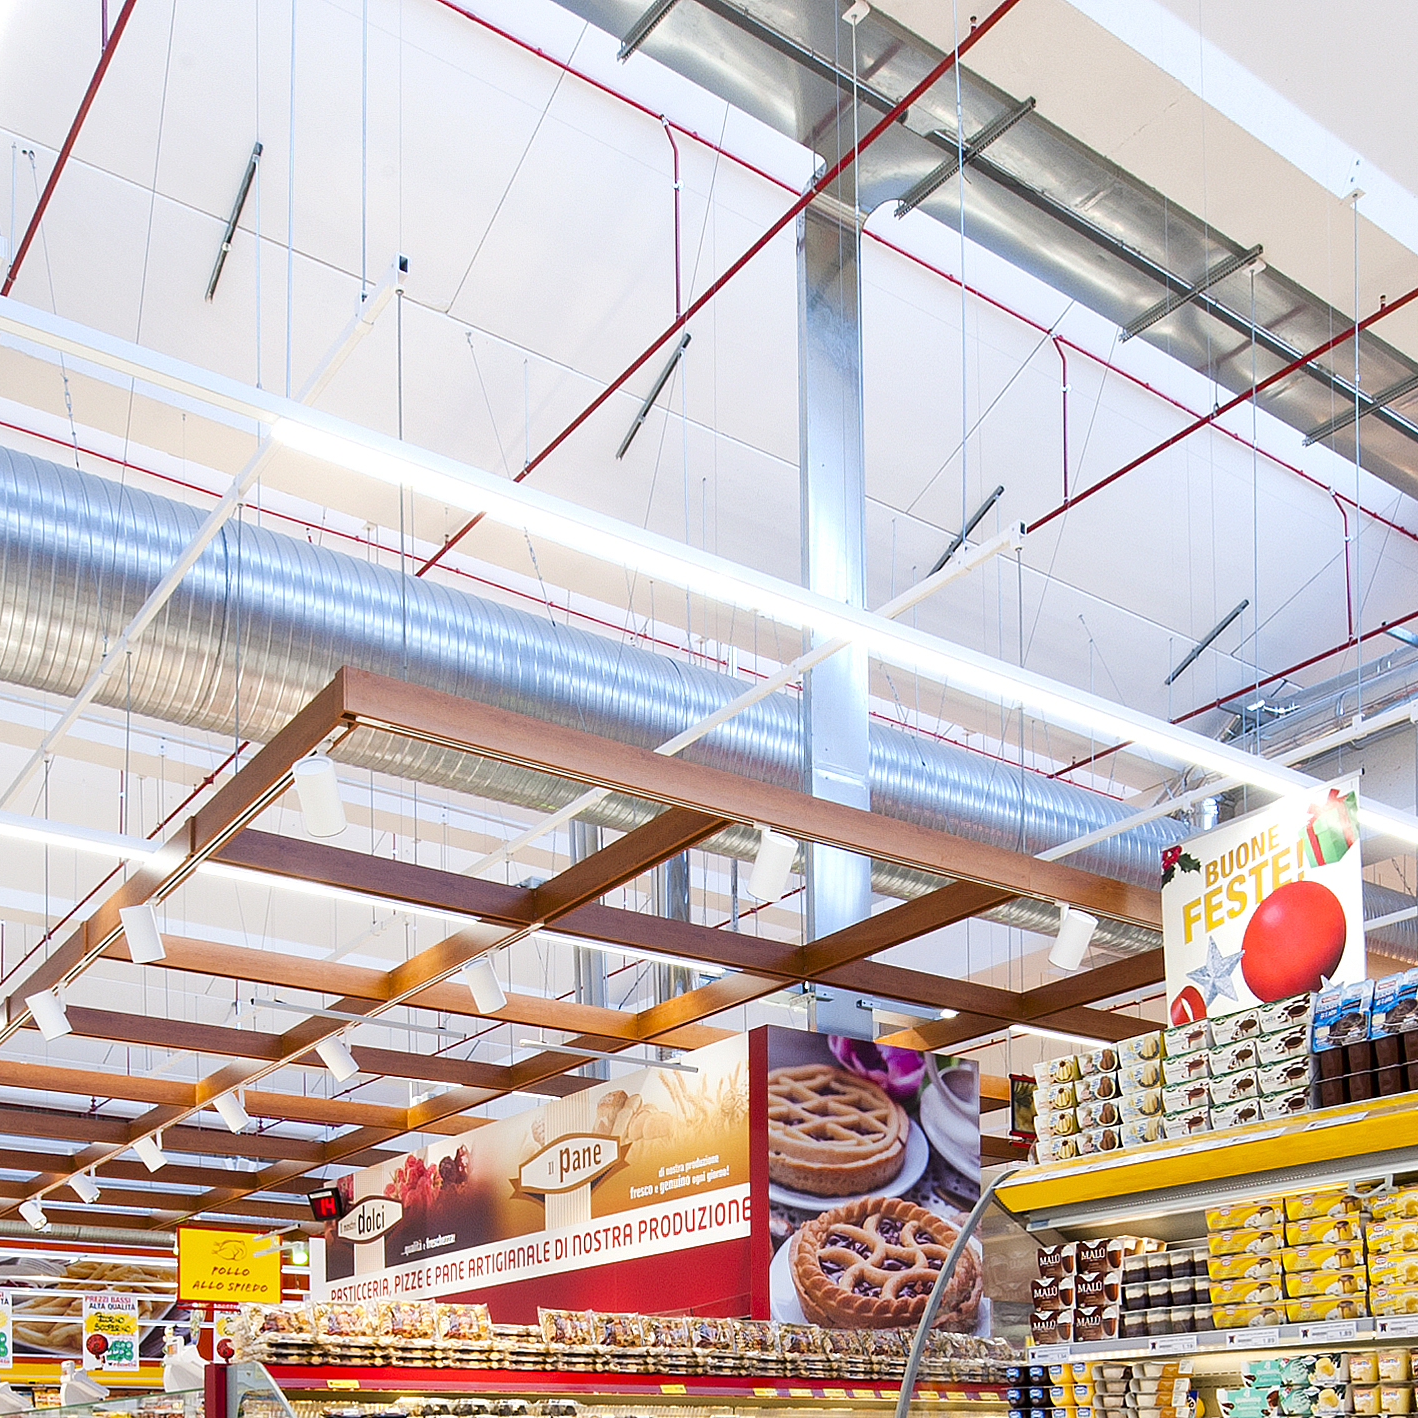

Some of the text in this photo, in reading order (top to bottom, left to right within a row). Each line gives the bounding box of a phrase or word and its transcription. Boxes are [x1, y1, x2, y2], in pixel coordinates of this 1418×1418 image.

[1205, 823, 1279, 889] BUONE
[1182, 837, 1305, 945] FESTE!
[559, 1143, 602, 1183] pane
[658, 1153, 720, 1178] di nostra produzione
[630, 1183, 654, 1200] fresco
[659, 1174, 691, 1196] genuino
[692, 1174, 706, 1187] ogni
[706, 1164, 730, 1182] giorno!
[358, 1205, 385, 1235] dolci
[394, 1269, 424, 1294] PIZZE
[426, 1267, 432, 1287] E
[435, 1260, 465, 1285] PANE
[468, 1242, 551, 1278] ARTIGIANALE
[555, 1237, 568, 1260] DI
[572, 1223, 633, 1257] NOSTRA
[638, 1196, 751, 1243] PRODUZIONE
[192, 1280, 268, 1293] ALLO SPIEDO
[211, 1266, 250, 1277] POLLO
[89, 1302, 106, 1311] ALTA
[110, 1296, 132, 1304] BASSI
